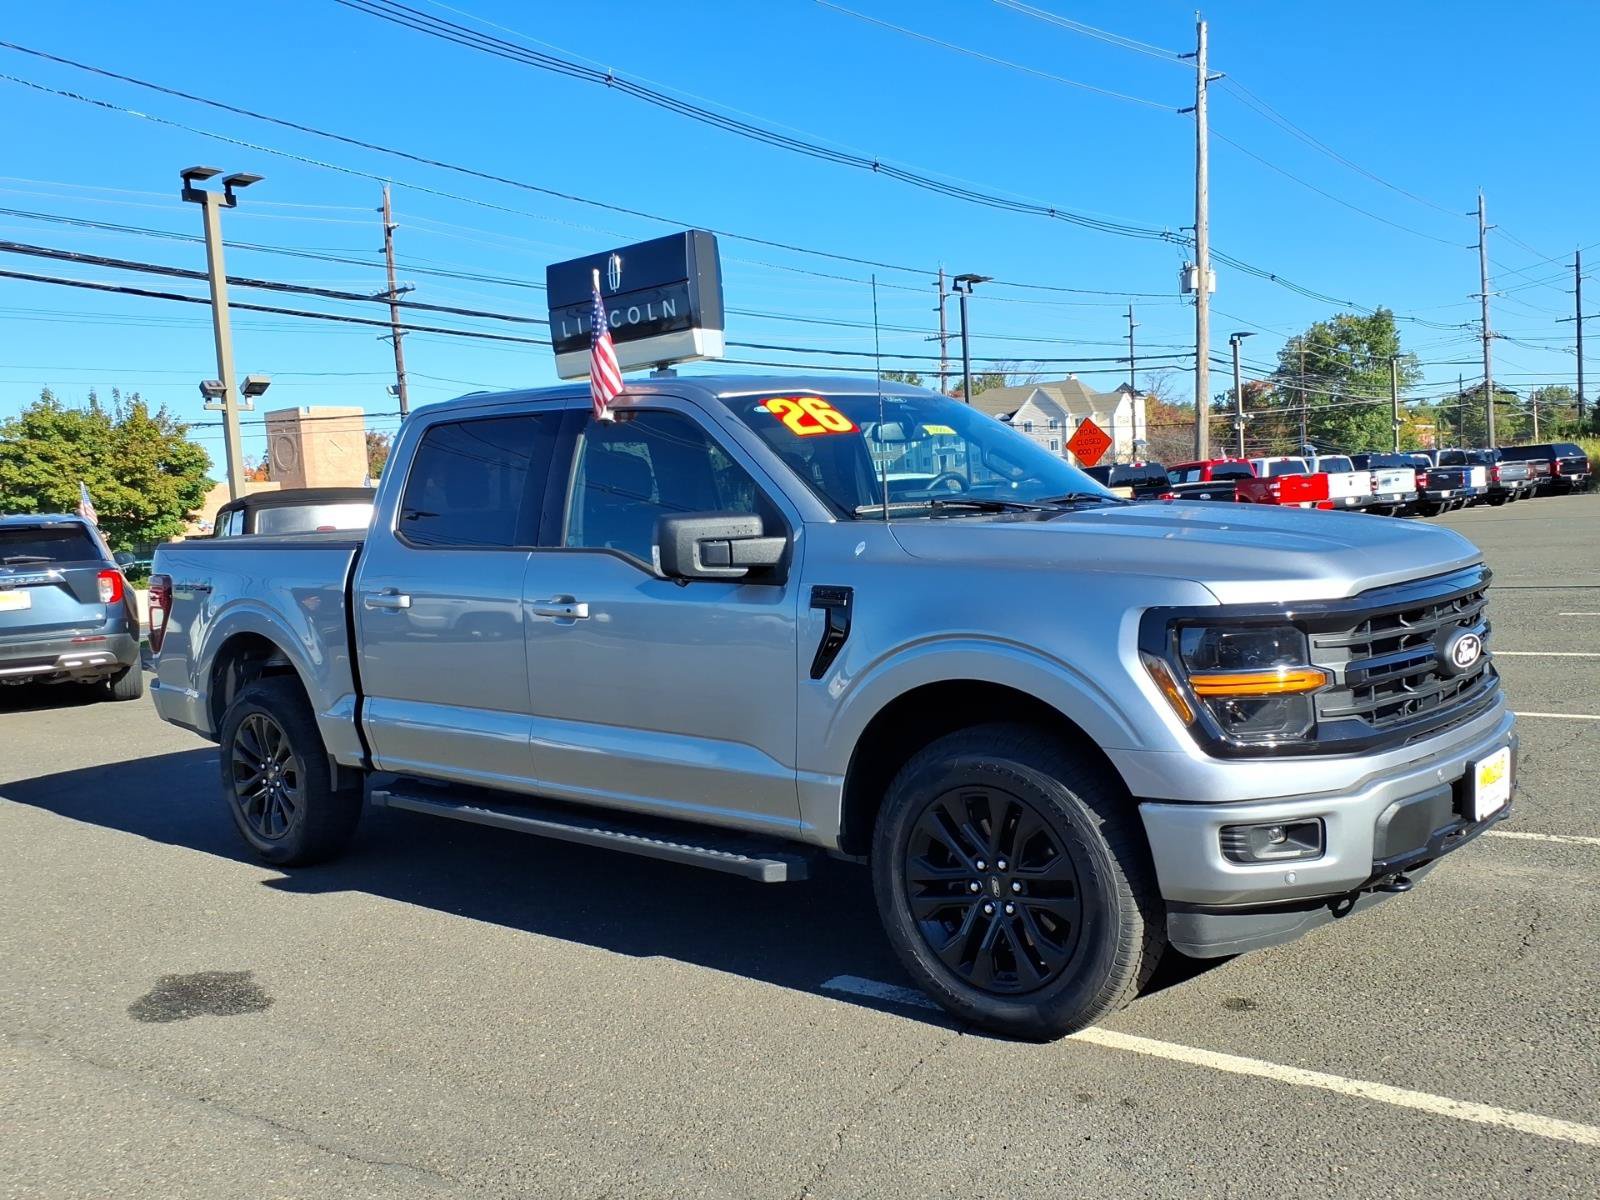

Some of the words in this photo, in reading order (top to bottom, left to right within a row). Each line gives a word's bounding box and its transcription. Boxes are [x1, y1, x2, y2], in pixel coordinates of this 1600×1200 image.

[561, 298, 677, 338] LICOLN
[766, 397, 853, 435] 26
[1076, 438, 1101, 446] CLOSED
[1079, 428, 1098, 436] ROAD
[1457, 637, 1478, 664] Ford
